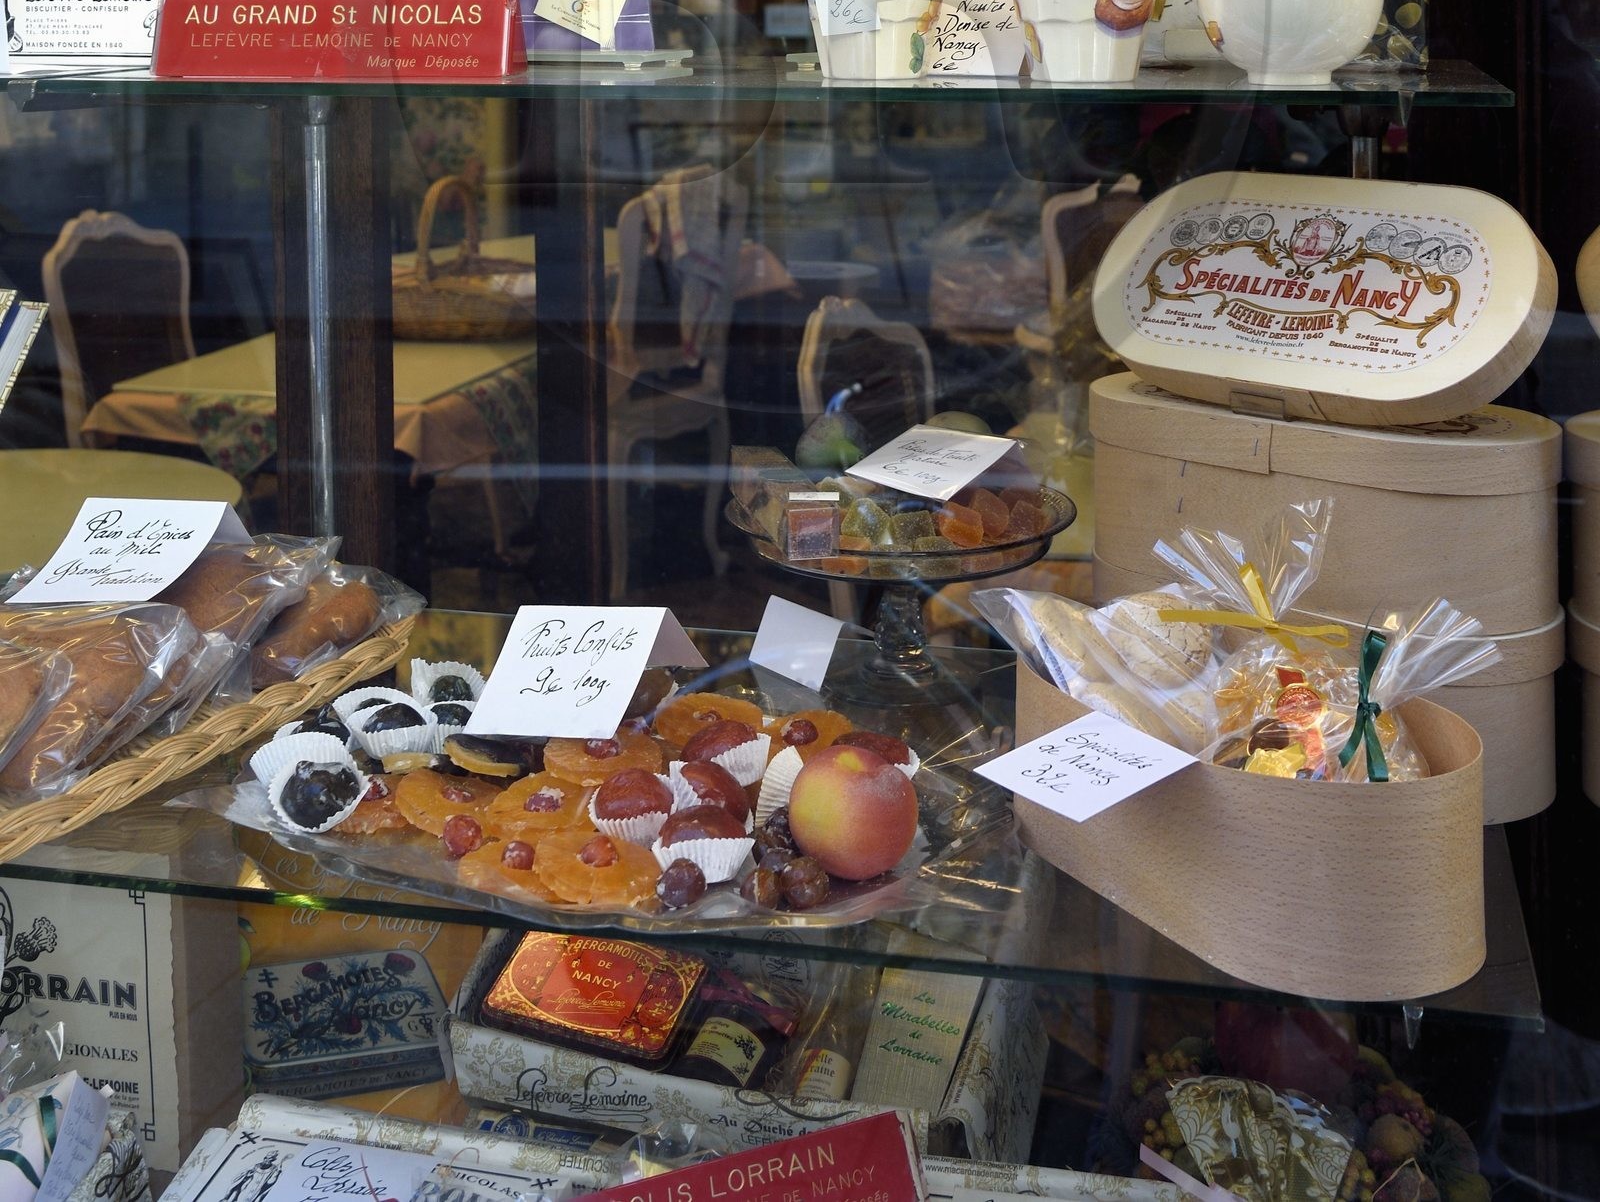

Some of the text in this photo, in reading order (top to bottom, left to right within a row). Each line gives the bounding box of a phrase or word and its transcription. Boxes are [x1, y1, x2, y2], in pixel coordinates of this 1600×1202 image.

[26, 5, 130, 13] BISCUITIER CONFISEUR
[184, 5, 483, 25] AU GRAND St NICOLAS
[26, 42, 55, 50] MAISON
[92, 42, 102, 50] EN
[105, 42, 124, 50] 1840
[190, 30, 474, 47] LEFÈVRE LEMOINE DE NANCY
[366, 53, 480, 72] Marque Déposée
[1174, 258, 1422, 317] SPÉCIALITÉS DE NANCY
[1226, 320, 1324, 340] FABRICANT DEPUIS 1840
[86, 509, 123, 542] Pain
[89, 546, 111, 556] au
[44, 559, 134, 585] Grande
[574, 938, 652, 966] BERGAMOTTES
[597, 959, 613, 970] DE
[572, 969, 622, 990] NANCY
[1, 969, 137, 1011] ORRAIN
[63, 1044, 139, 1063] GIONALES
[879, 1038, 943, 1065] Lorraine
[710, 1142, 836, 1198] LORRAIN
[812, 1165, 876, 1196] NANCY
